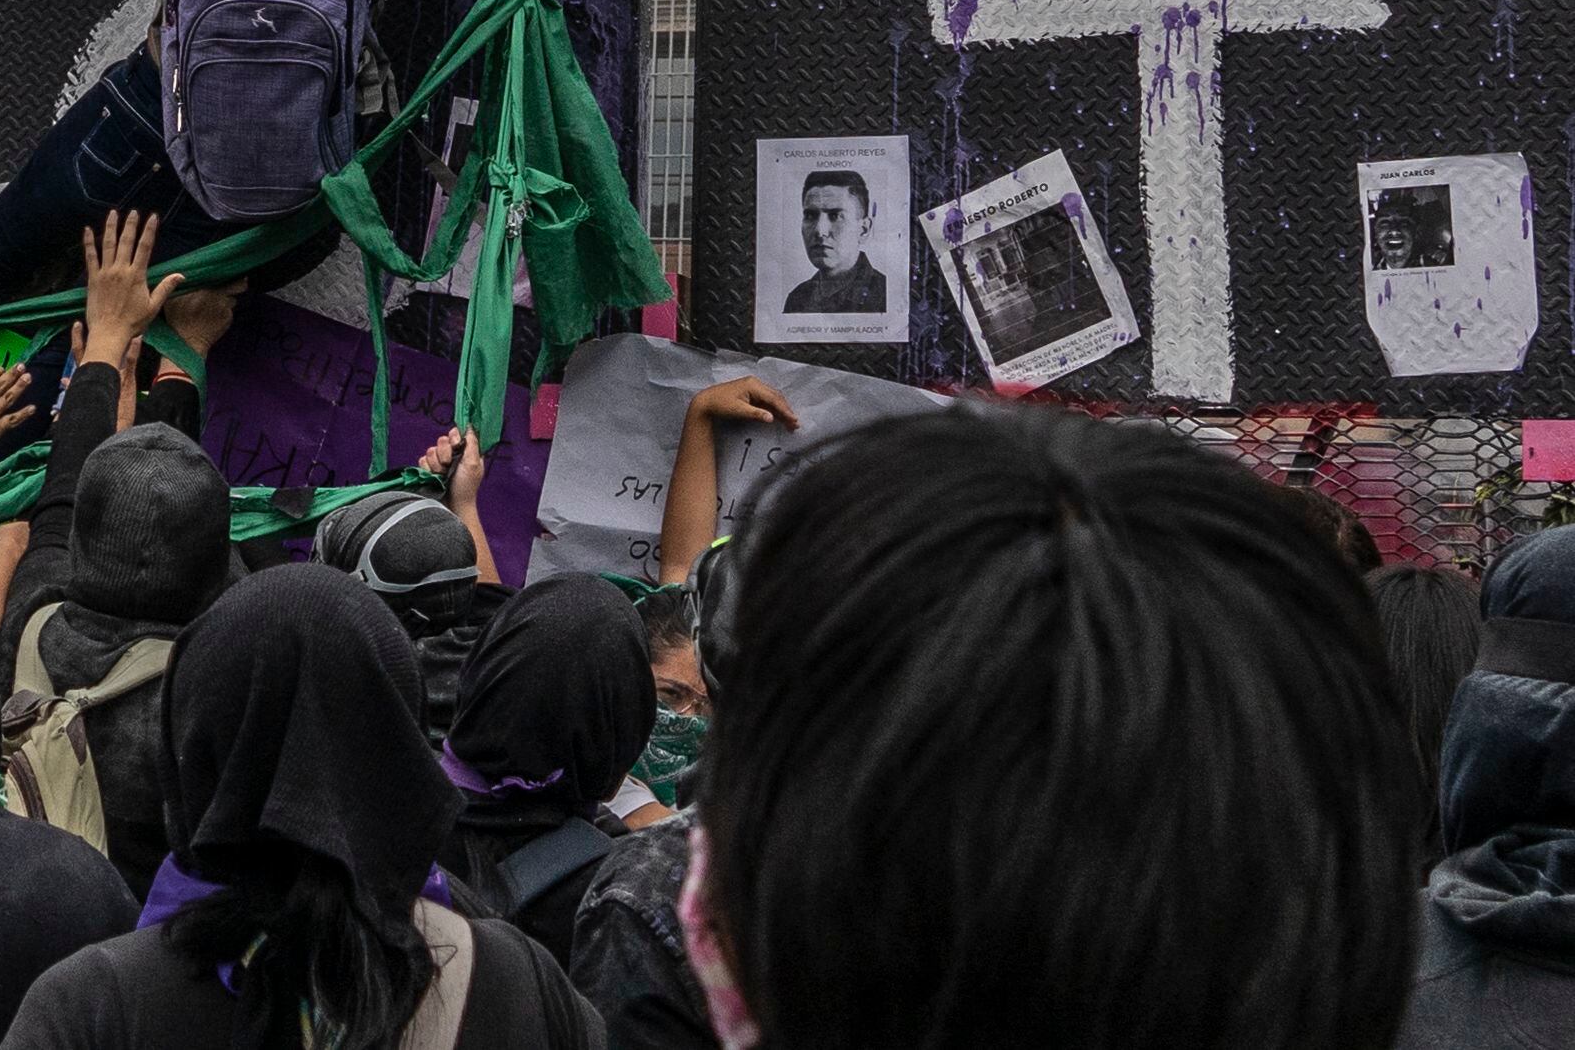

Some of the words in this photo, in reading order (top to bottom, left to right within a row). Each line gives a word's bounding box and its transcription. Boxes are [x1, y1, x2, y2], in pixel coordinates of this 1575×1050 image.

[784, 150, 817, 158] CARLOS
[818, 149, 856, 158] ALBERTO
[857, 148, 886, 157] REYES
[816, 160, 852, 168] MONROY
[1380, 172, 1400, 180] JUAN
[1403, 169, 1436, 178] CARLOS
[998, 183, 1049, 211] ROBERTO
[787, 326, 821, 334] AGRESOR
[830, 326, 884, 334] MANIPULADOR
[615, 476, 663, 504] LAS
